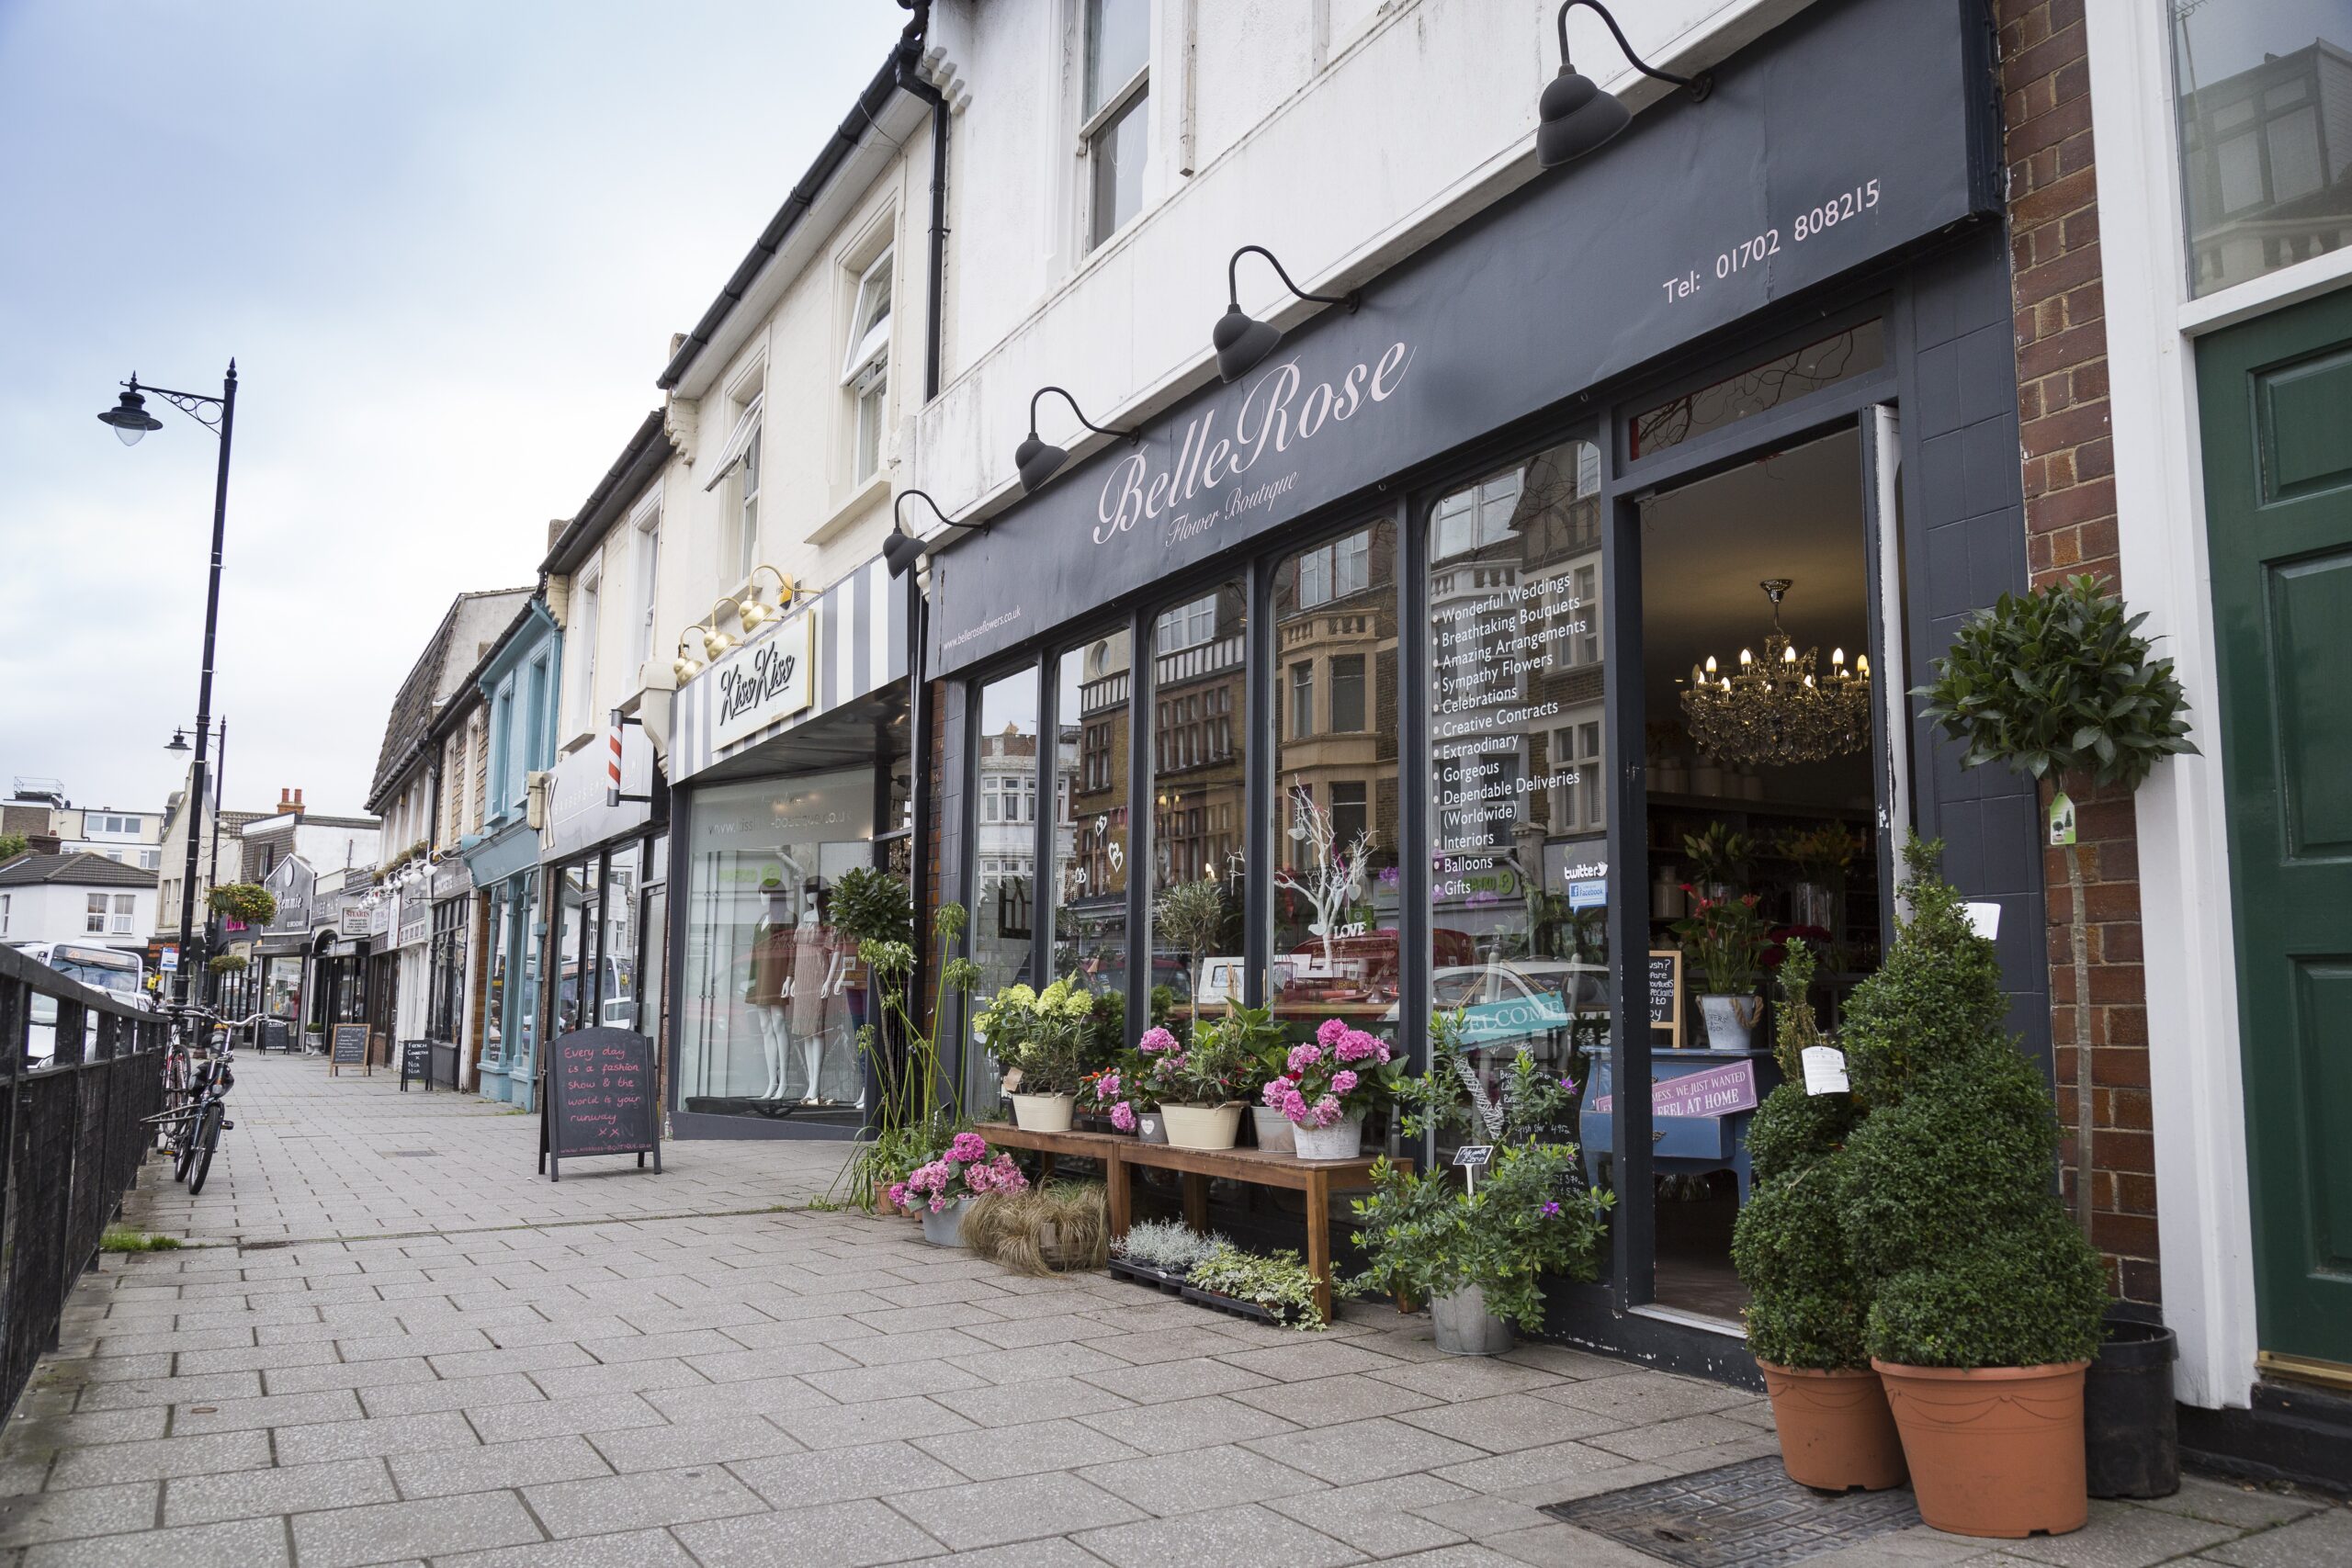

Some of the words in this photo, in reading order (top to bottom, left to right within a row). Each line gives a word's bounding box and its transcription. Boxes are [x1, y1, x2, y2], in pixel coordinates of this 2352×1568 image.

[1663, 270, 1701, 303] Tel:
[1716, 229, 1781, 279] 01702
[1794, 178, 1881, 242] 808215
[1165, 507, 1220, 547] Flower
[1225, 469, 1301, 518] Boutique
[1442, 592, 1503, 625] Wonderful
[1508, 574, 1570, 603] Weddings
[943, 604, 1022, 651] www.belleroseflowers.co.uk
[1442, 615, 1516, 648] Breathtaking
[1520, 597, 1580, 625] Bouquets
[1442, 646, 1492, 670] Amazing
[1496, 620, 1587, 656] Arrangements
[1442, 666, 1498, 695] Sympathy
[1502, 653, 1554, 677] Flowers
[1442, 687, 1517, 715] Celebrations
[1442, 716, 1493, 737] Creative
[1496, 701, 1559, 725] Contracts
[1442, 735, 1520, 761] Extraodinary
[1443, 761, 1499, 784] Gorgeous
[1443, 781, 1512, 807] Dependable
[1516, 771, 1580, 794] Deliveries
[1443, 800, 1518, 829] (Worldwide)
[1444, 831, 1494, 851] Interiors
[1444, 856, 1494, 873] Balloons
[1565, 863, 1598, 880] twitter
[1444, 879, 1471, 896] Gifts
[1334, 921, 1367, 939] LOVE
[1468, 999, 1561, 1032] ELCOME
[564, 1046, 594, 1062] Every
[602, 1045, 626, 1060] day
[568, 1064, 579, 1074] is
[585, 1065, 594, 1073] a
[602, 1063, 640, 1076] fashion
[568, 1079, 595, 1090] show
[602, 1077, 611, 1088] &
[617, 1076, 635, 1088] the
[1652, 1089, 1675, 1103] MESS.
[1676, 1084, 1689, 1097] WE
[1690, 1079, 1709, 1096] JUST
[1711, 1071, 1746, 1089] WANTED
[568, 1096, 600, 1107] world
[605, 1095, 612, 1103] is
[616, 1095, 641, 1108] your
[1687, 1096, 1702, 1114] AT
[1704, 1088, 1739, 1110] HOME
[570, 1114, 617, 1125] runway
